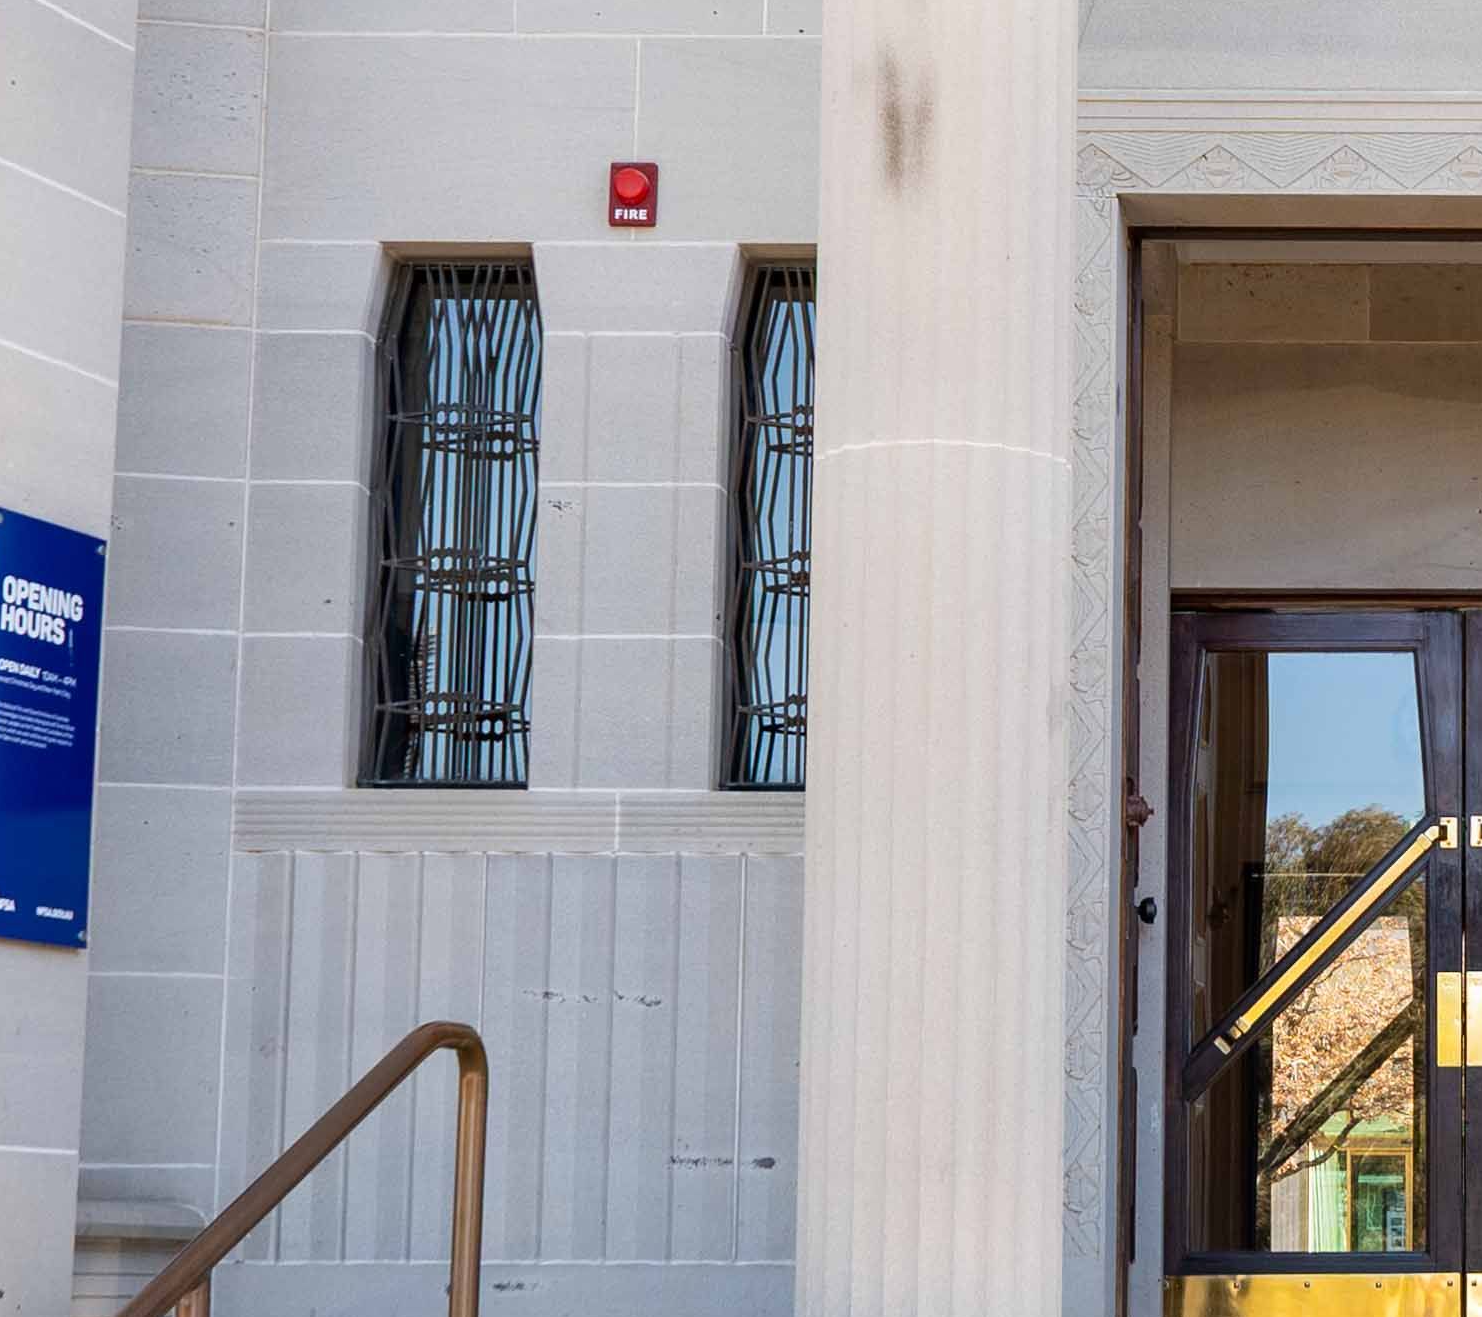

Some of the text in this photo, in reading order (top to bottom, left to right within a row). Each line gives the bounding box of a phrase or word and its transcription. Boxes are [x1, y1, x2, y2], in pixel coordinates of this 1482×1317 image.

[614, 208, 648, 220] FIRE
[2, 574, 84, 622] OPENING
[0, 603, 66, 645] HOURS
